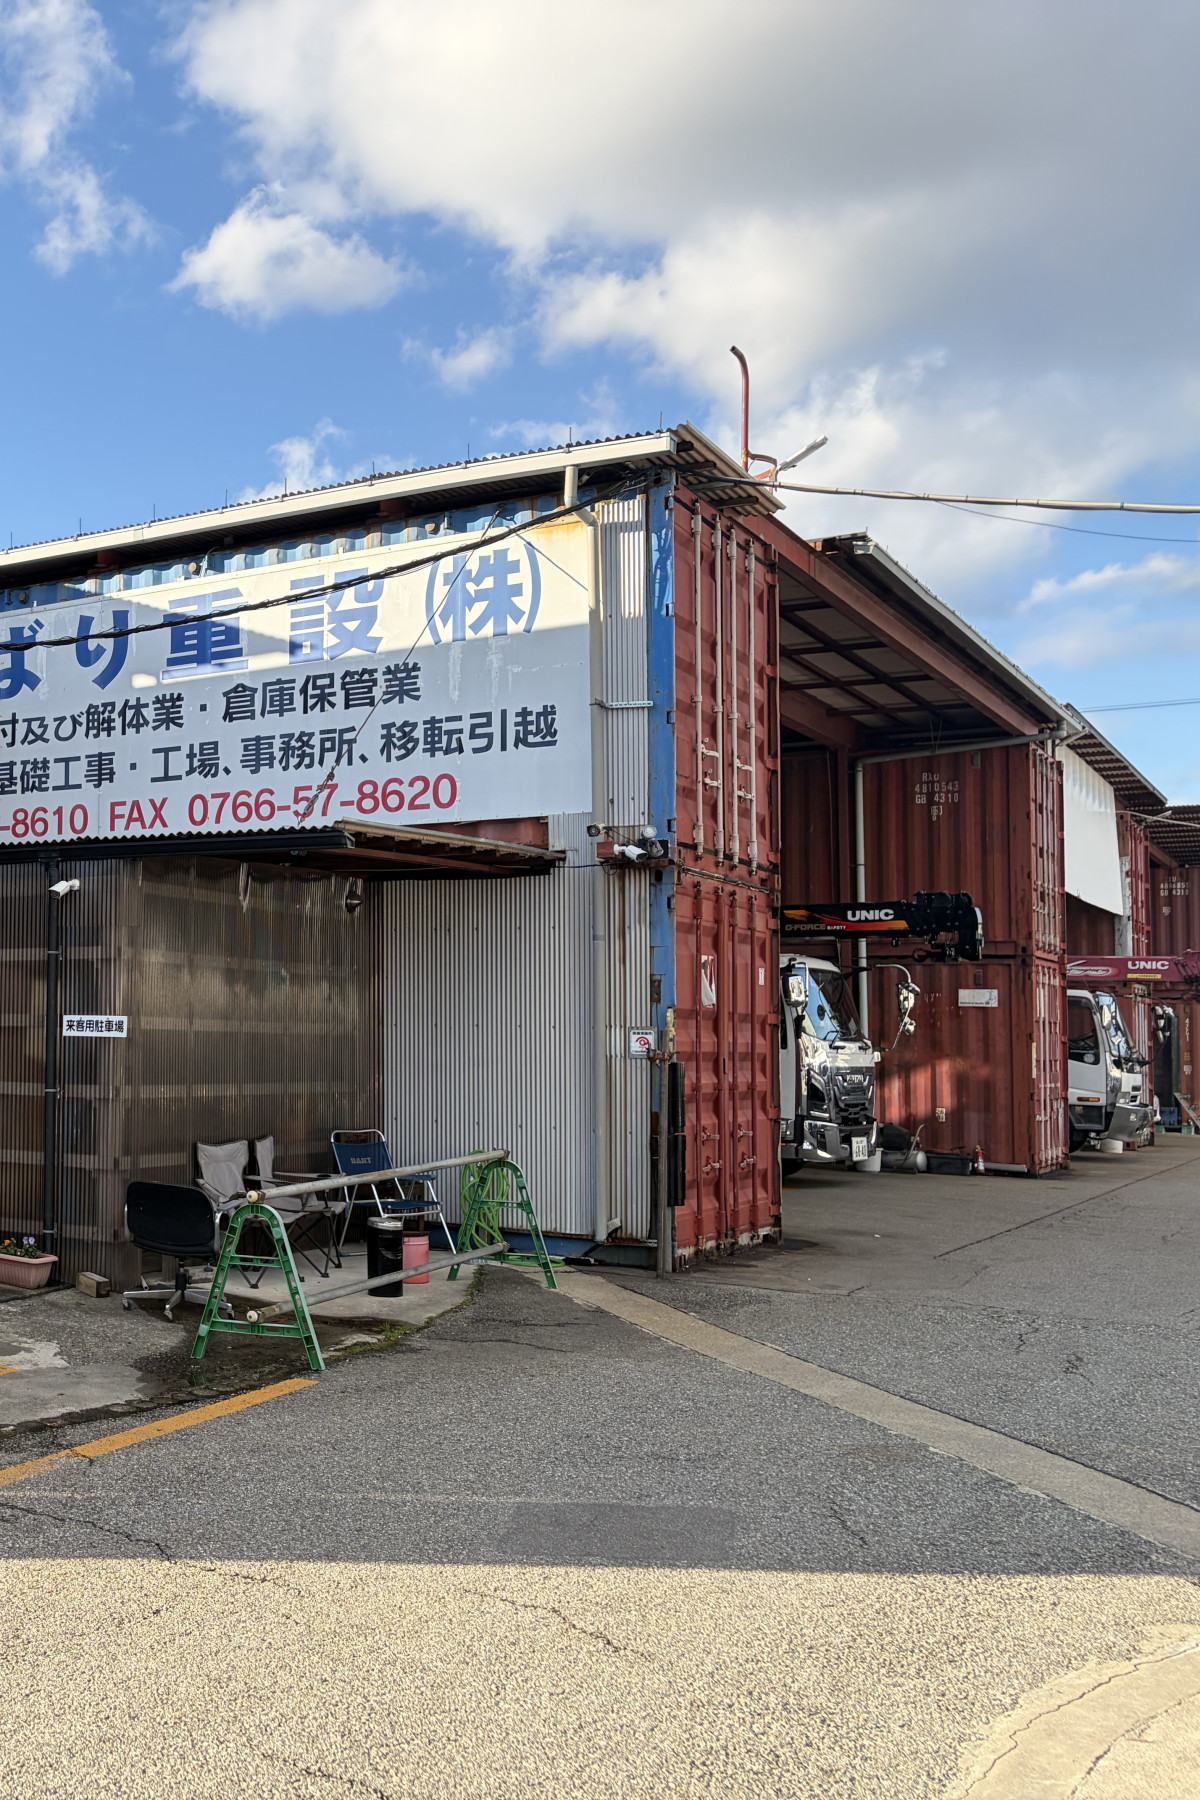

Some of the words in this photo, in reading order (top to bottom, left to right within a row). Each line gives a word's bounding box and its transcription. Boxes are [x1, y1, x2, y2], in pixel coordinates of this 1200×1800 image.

[109, 797, 168, 832] FAX
[188, 773, 458, 827] 0766-57-8620
[847, 908, 895, 921] UNIC
[1127, 960, 1170, 970] UNIC
[65, 1019, 125, 1033] 来客用駐車場
